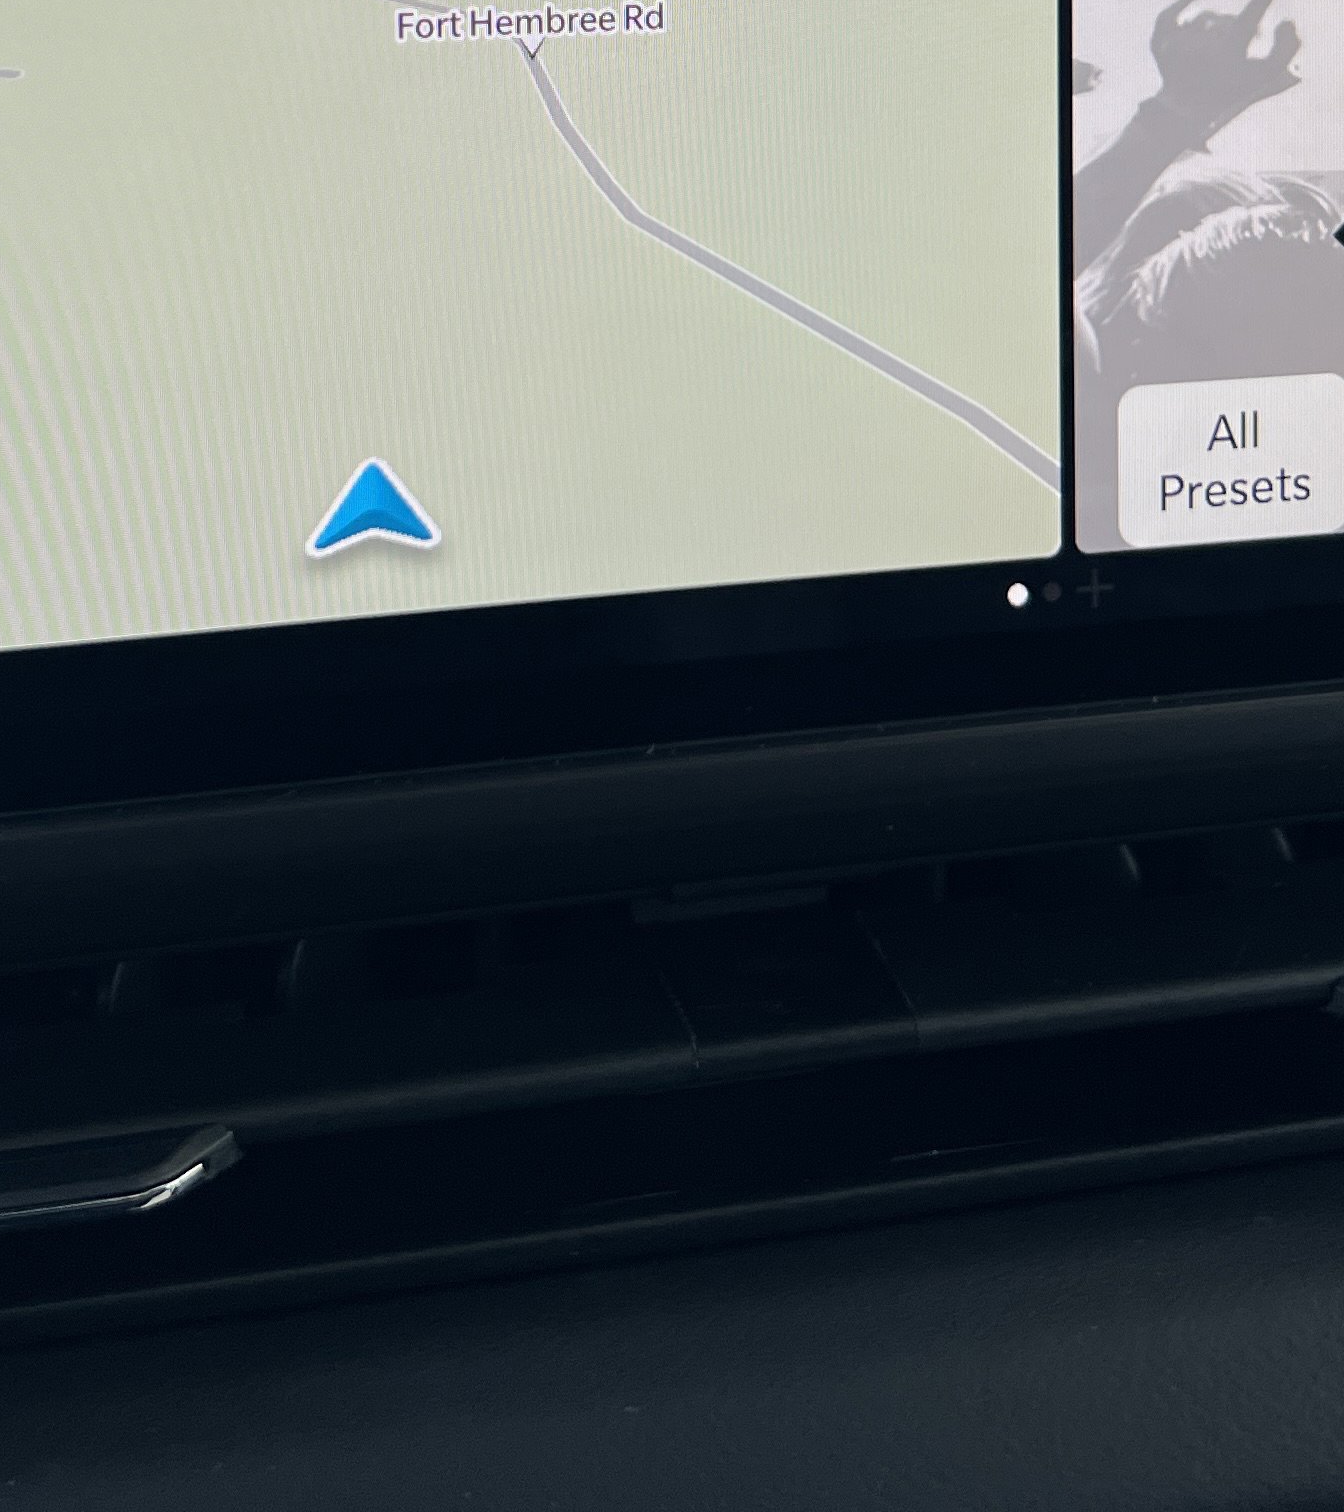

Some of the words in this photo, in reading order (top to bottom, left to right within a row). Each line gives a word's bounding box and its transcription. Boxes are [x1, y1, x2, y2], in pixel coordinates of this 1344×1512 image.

[398, 10, 462, 39] Fort
[470, 8, 616, 36] Hembree
[625, 3, 665, 31] Rd
[1207, 410, 1259, 452] All
[1160, 467, 1311, 512] Presets
